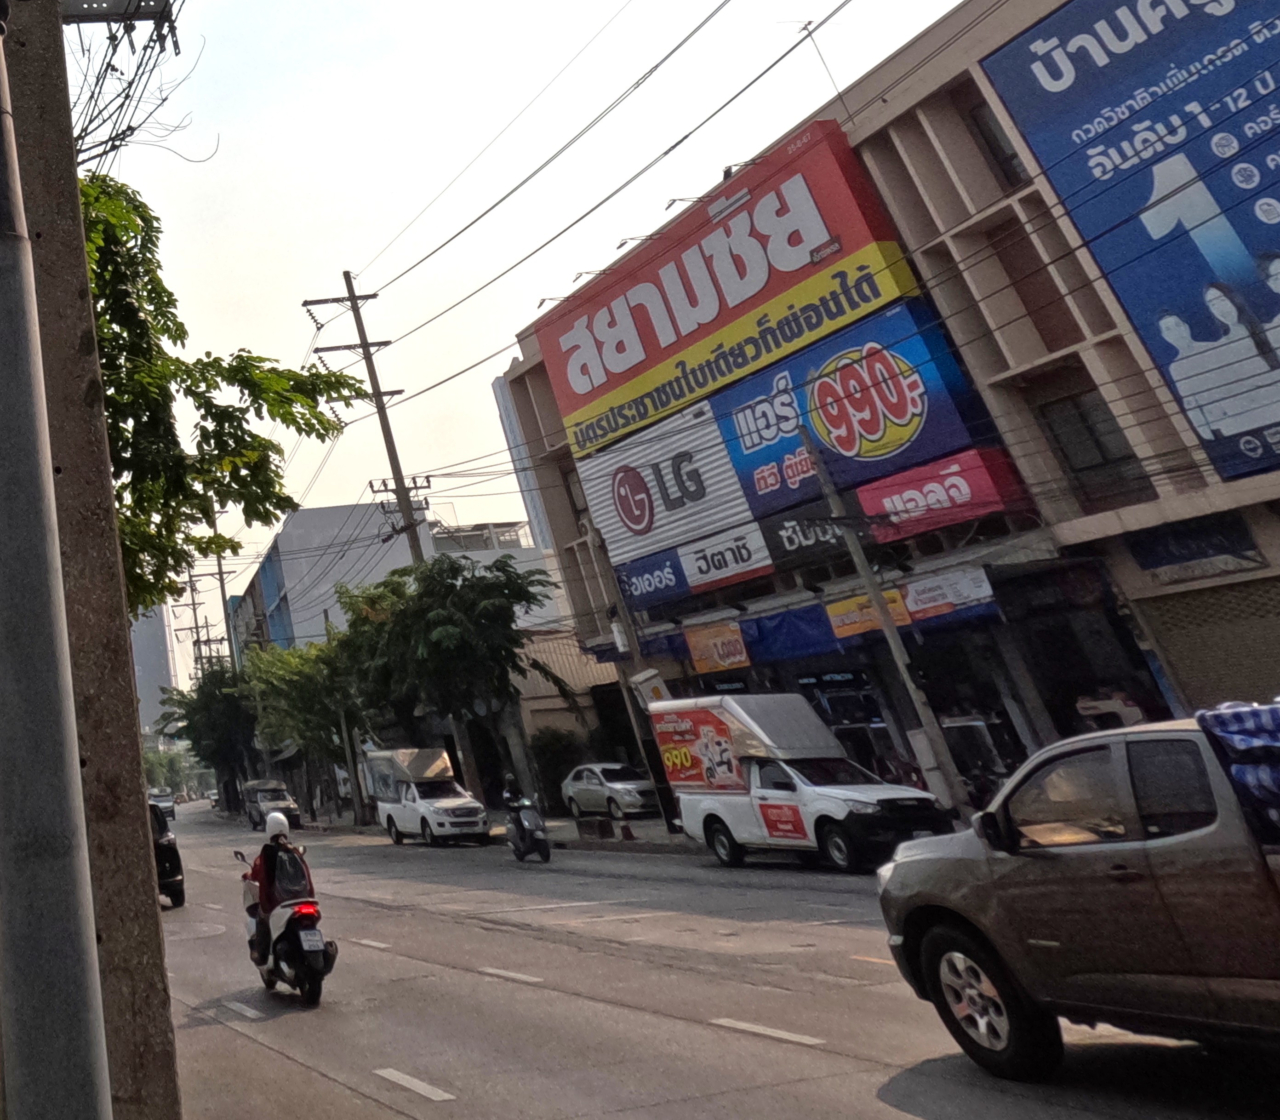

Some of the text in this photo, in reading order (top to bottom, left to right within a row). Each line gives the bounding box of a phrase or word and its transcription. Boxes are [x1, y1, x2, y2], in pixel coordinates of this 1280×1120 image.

[1086, 114, 1188, 181] อันดับ
[558, 172, 832, 395] สยามชัย
[573, 265, 882, 451] บัตรประชาชนใบเดียวก็ผ่อนได้
[733, 371, 803, 454] แอร์
[650, 450, 707, 512] LG
[754, 461, 782, 495] ทีวี
[882, 463, 971, 524] แอลจี
[693, 536, 753, 576] ฮิตาชิ
[778, 520, 845, 551] ซัมซุ
